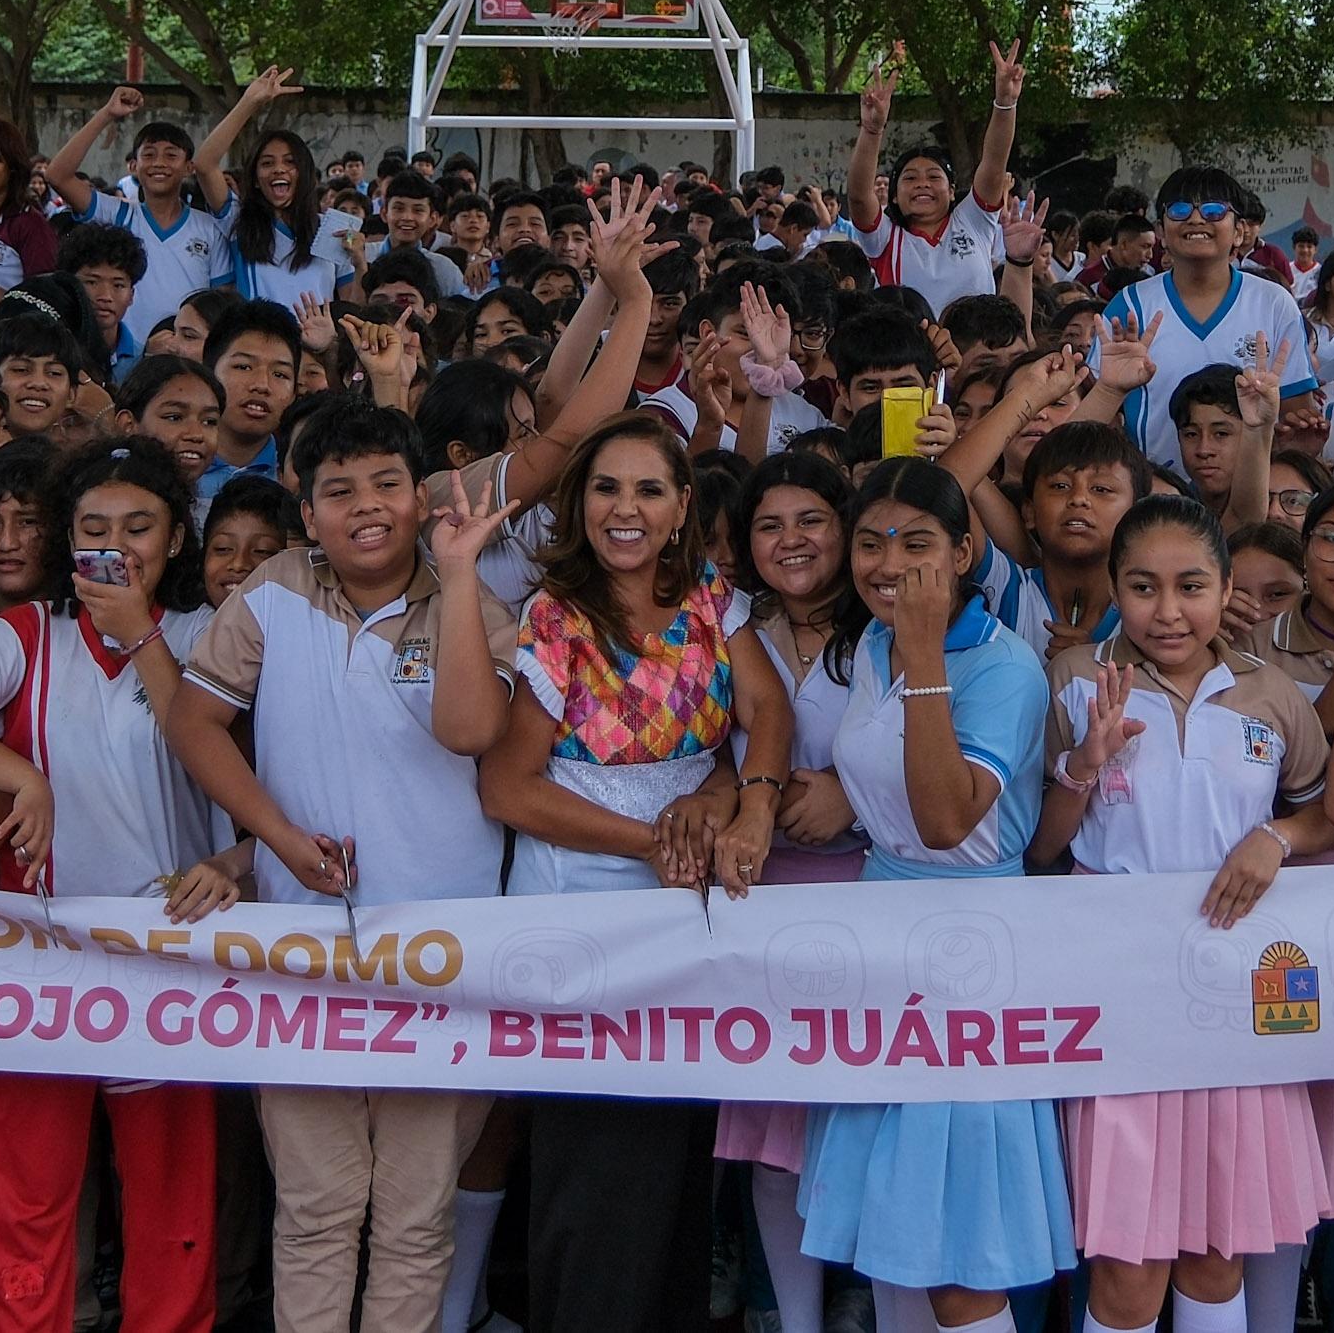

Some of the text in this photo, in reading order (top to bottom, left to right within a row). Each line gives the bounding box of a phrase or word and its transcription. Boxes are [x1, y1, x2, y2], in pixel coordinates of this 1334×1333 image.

[214, 928, 464, 987] DOMO
[488, 1004, 773, 1065] BENITO
[788, 992, 1105, 1068] JUÁREZ
